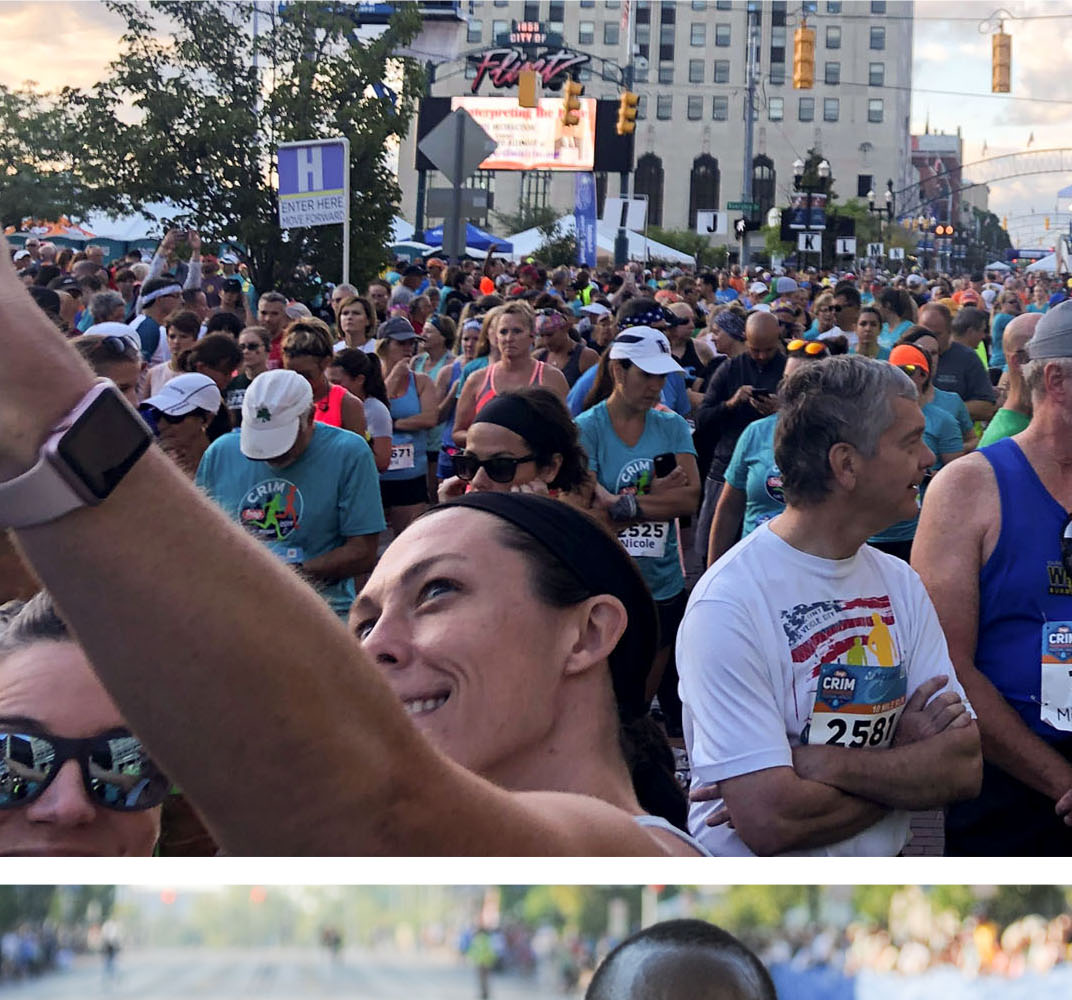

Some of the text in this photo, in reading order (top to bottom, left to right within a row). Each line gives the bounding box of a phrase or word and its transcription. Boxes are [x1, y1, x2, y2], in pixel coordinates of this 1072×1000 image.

[510, 33, 547, 43] CITY OF
[471, 50, 590, 92] Flint
[467, 108, 531, 120] nterpreting
[297, 146, 325, 193] H
[281, 196, 344, 214] ENTER HERE
[281, 210, 345, 227] MOVE FORWARD
[706, 213, 718, 233] J
[805, 234, 815, 250] K
[842, 241, 850, 253] L
[871, 244, 881, 254] M
[893, 250, 900, 258] N
[621, 460, 650, 483] CRIM
[247, 481, 285, 503] CRIM
[620, 538, 655, 549] Nicole
[822, 676, 857, 692] CRIM
[872, 703, 881, 713] 10
[826, 713, 897, 748] 2581
